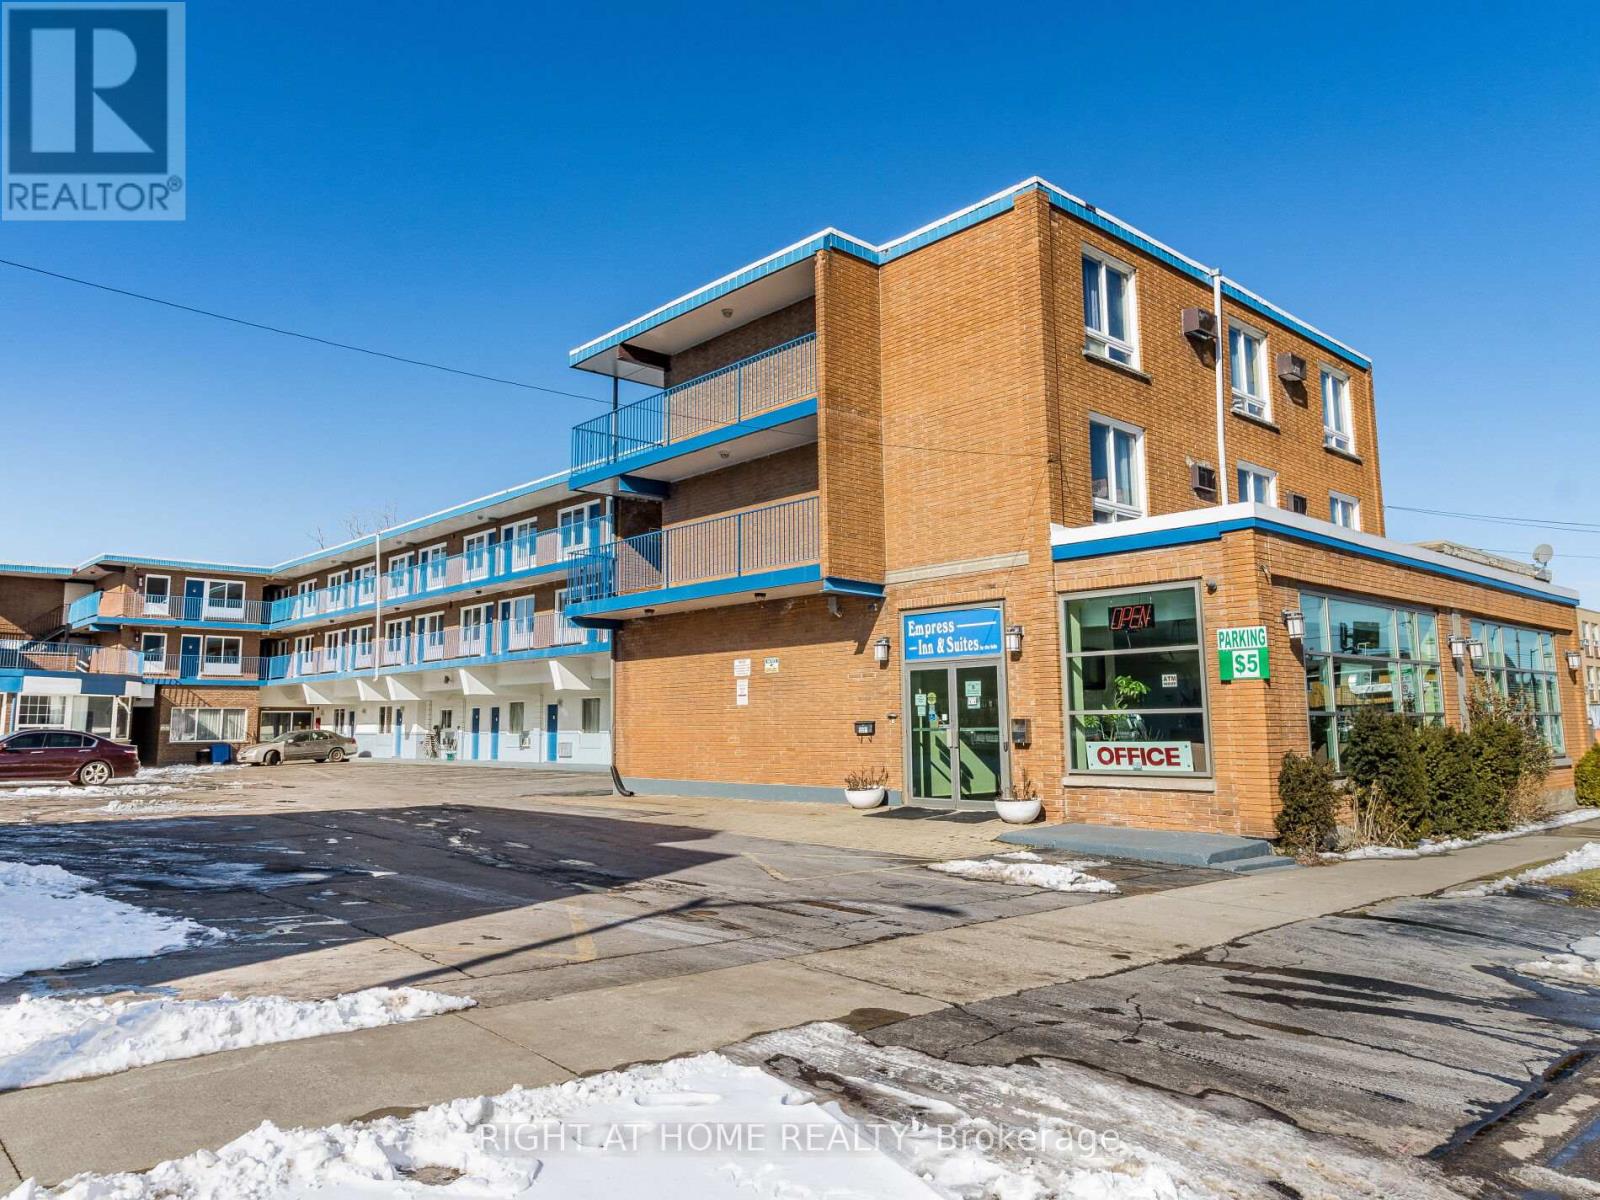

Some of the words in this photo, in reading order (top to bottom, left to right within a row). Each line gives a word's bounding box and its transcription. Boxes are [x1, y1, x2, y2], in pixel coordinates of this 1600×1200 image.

[1111, 605, 1151, 630] OPEN
[908, 620, 955, 638] Empress
[1218, 628, 1266, 648] PARKING
[918, 640, 934, 655] Inn
[937, 637, 945, 654] &
[947, 636, 979, 653] Suites
[1097, 747, 1181, 767] OFFICE
